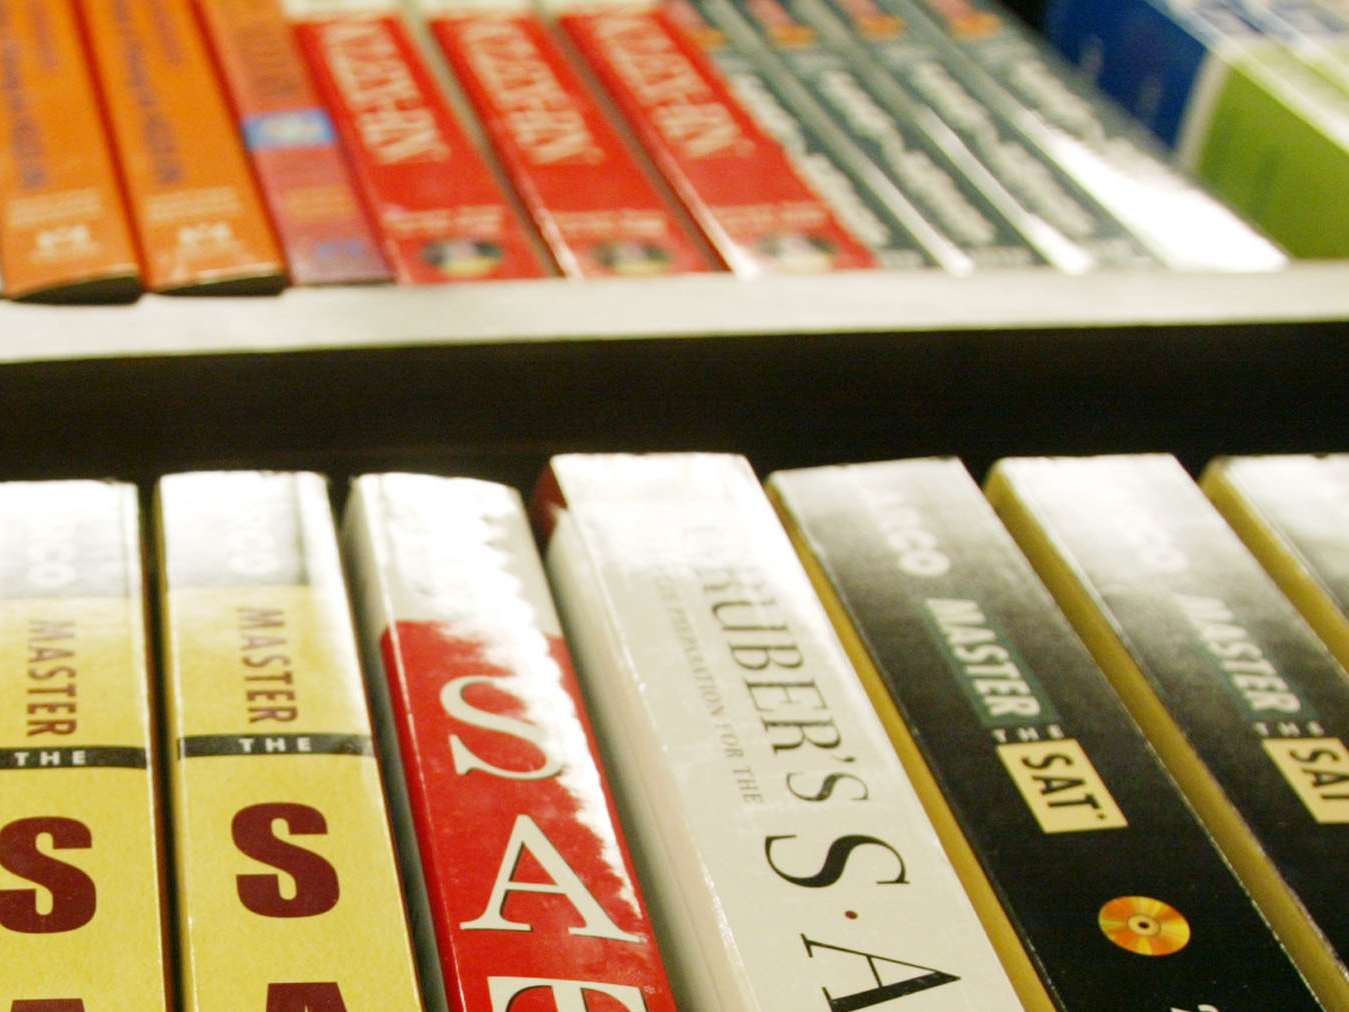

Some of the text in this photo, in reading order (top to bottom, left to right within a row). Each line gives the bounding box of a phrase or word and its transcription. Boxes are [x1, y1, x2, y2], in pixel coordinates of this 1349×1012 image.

[26, 619, 77, 738] MASTER
[236, 606, 299, 724] MASTER
[688, 535, 870, 802] RUBER'S
[926, 598, 1041, 716] MASTER
[1176, 595, 1301, 714] MASTER
[15, 748, 86, 767] THE
[238, 734, 311, 754] THE
